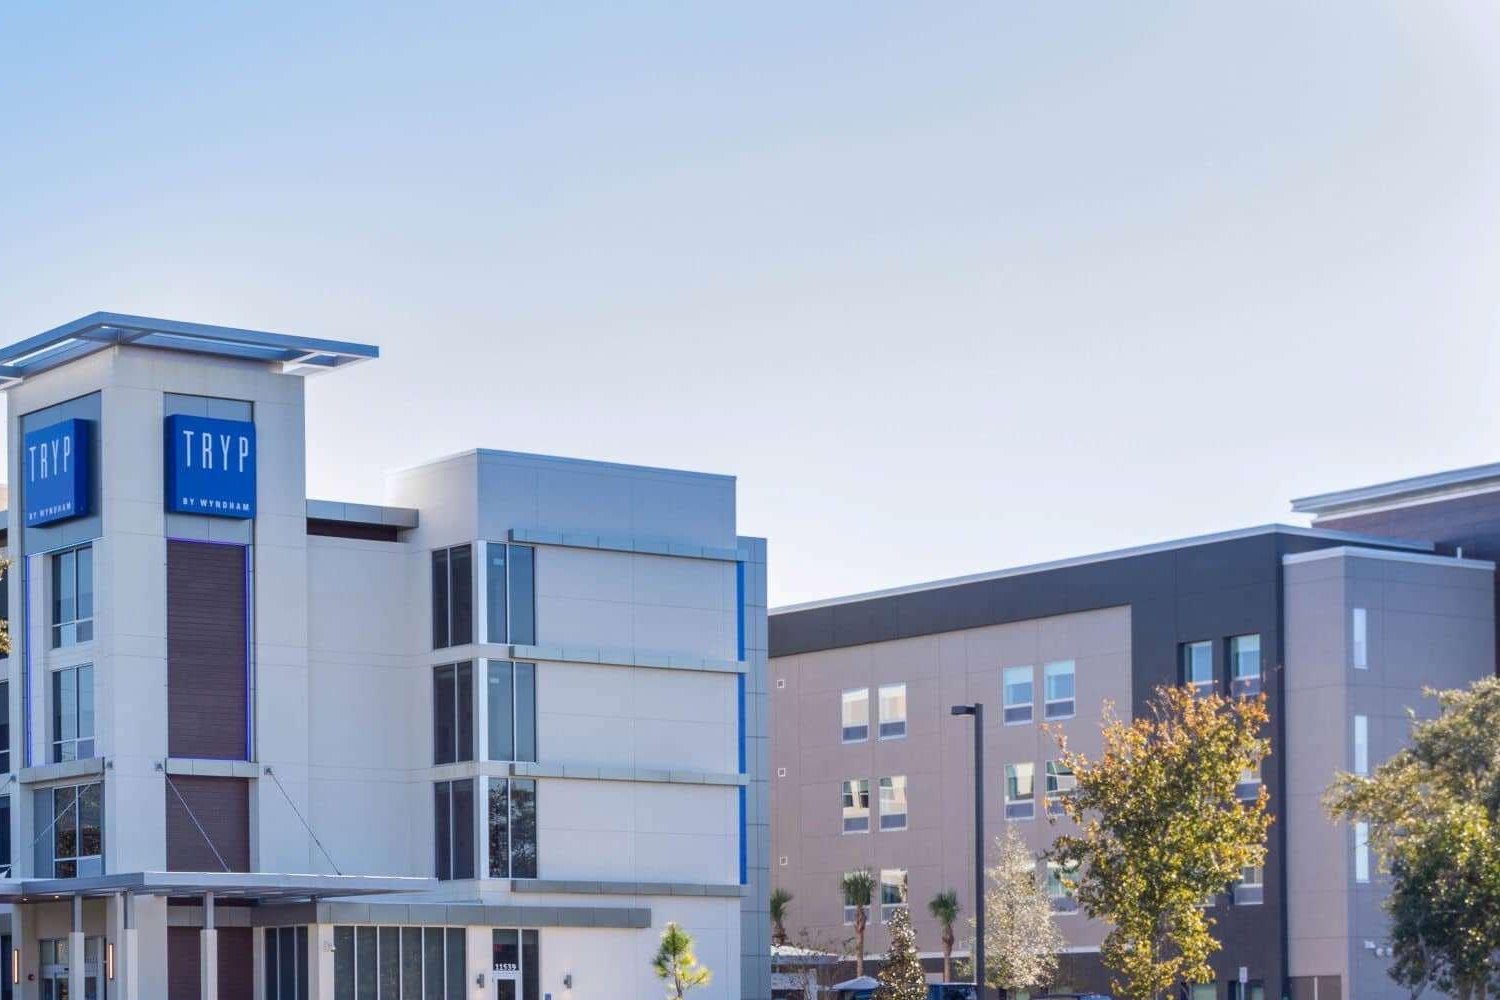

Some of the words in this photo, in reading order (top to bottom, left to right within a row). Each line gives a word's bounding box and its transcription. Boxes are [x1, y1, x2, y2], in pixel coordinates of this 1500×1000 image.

[29, 436, 70, 482] TRYP
[182, 430, 249, 472] TRYP
[182, 497, 195, 505] BY
[200, 499, 249, 511] WYNDHAM
